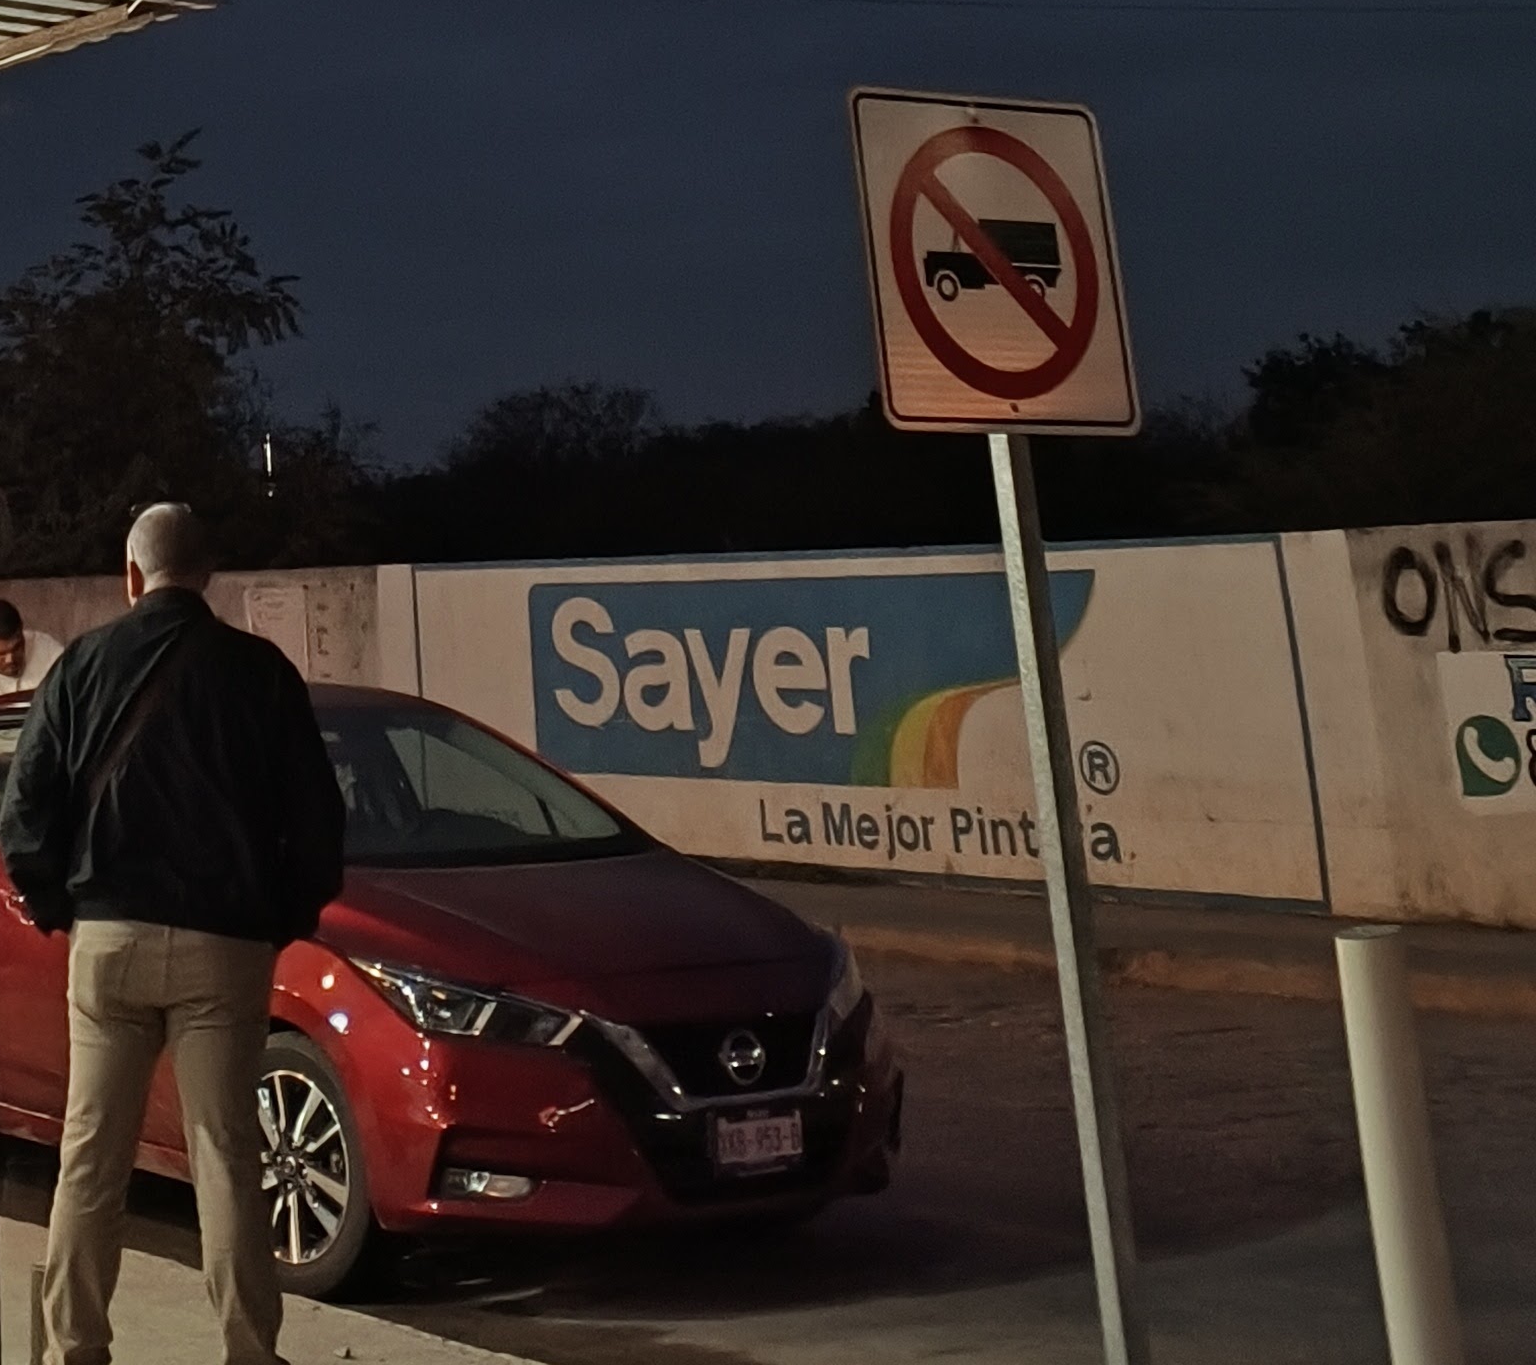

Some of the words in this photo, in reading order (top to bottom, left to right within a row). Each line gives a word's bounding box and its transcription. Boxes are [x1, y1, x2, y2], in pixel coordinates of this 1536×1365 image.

[551, 596, 870, 769] Sayer
[759, 798, 812, 846] La
[821, 800, 935, 861] Mejor
[949, 805, 1123, 864] Pinta
